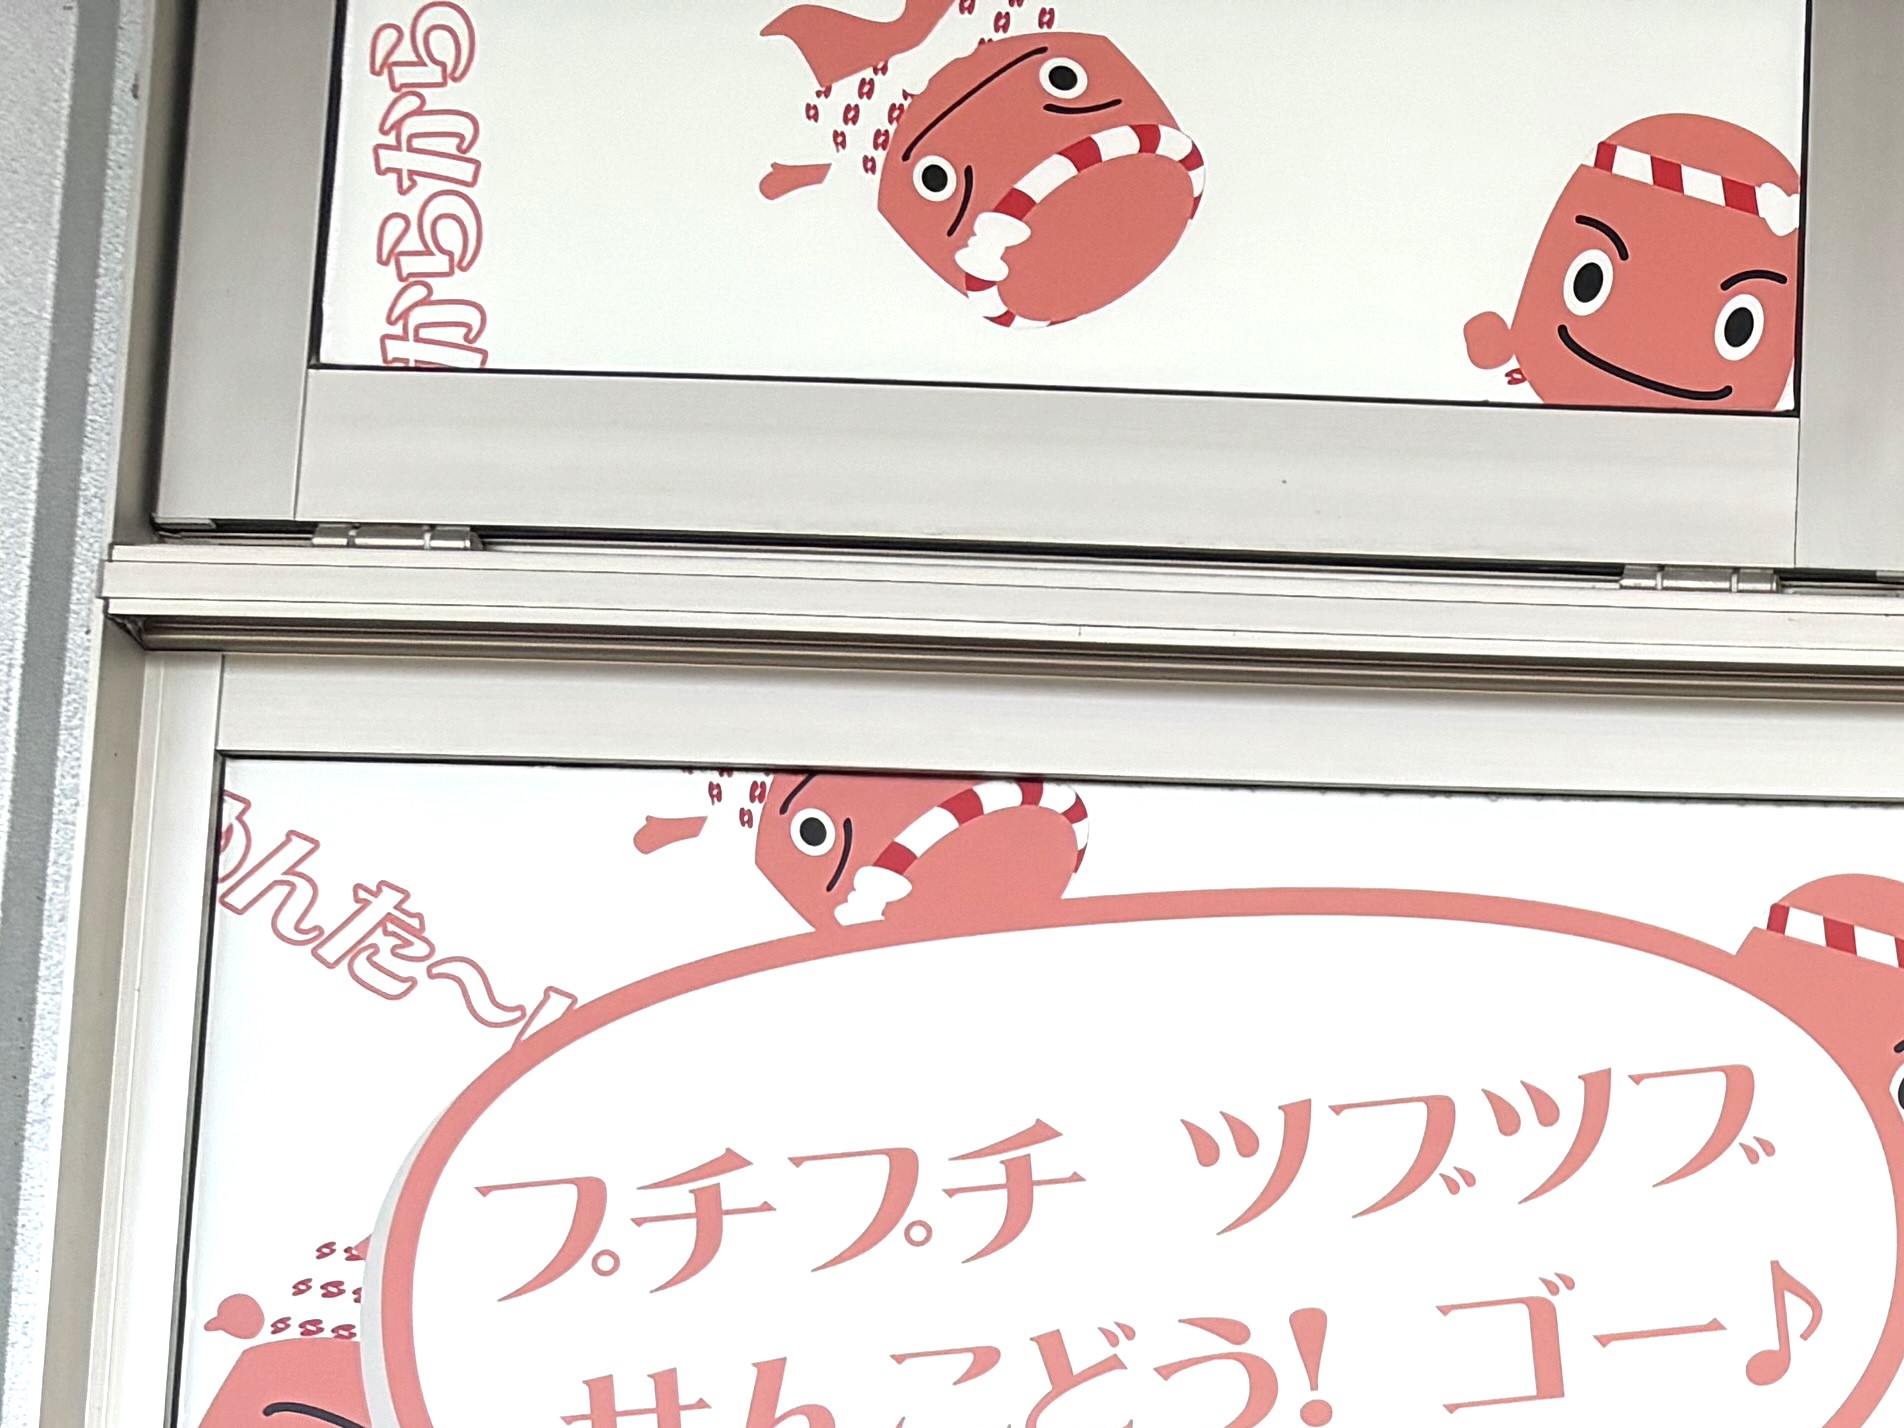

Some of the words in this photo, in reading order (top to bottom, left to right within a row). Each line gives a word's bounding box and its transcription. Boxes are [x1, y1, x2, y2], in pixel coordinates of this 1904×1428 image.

[474, 1117, 1087, 1302] プチプチ
[1181, 1064, 1776, 1236] ツブツブ
